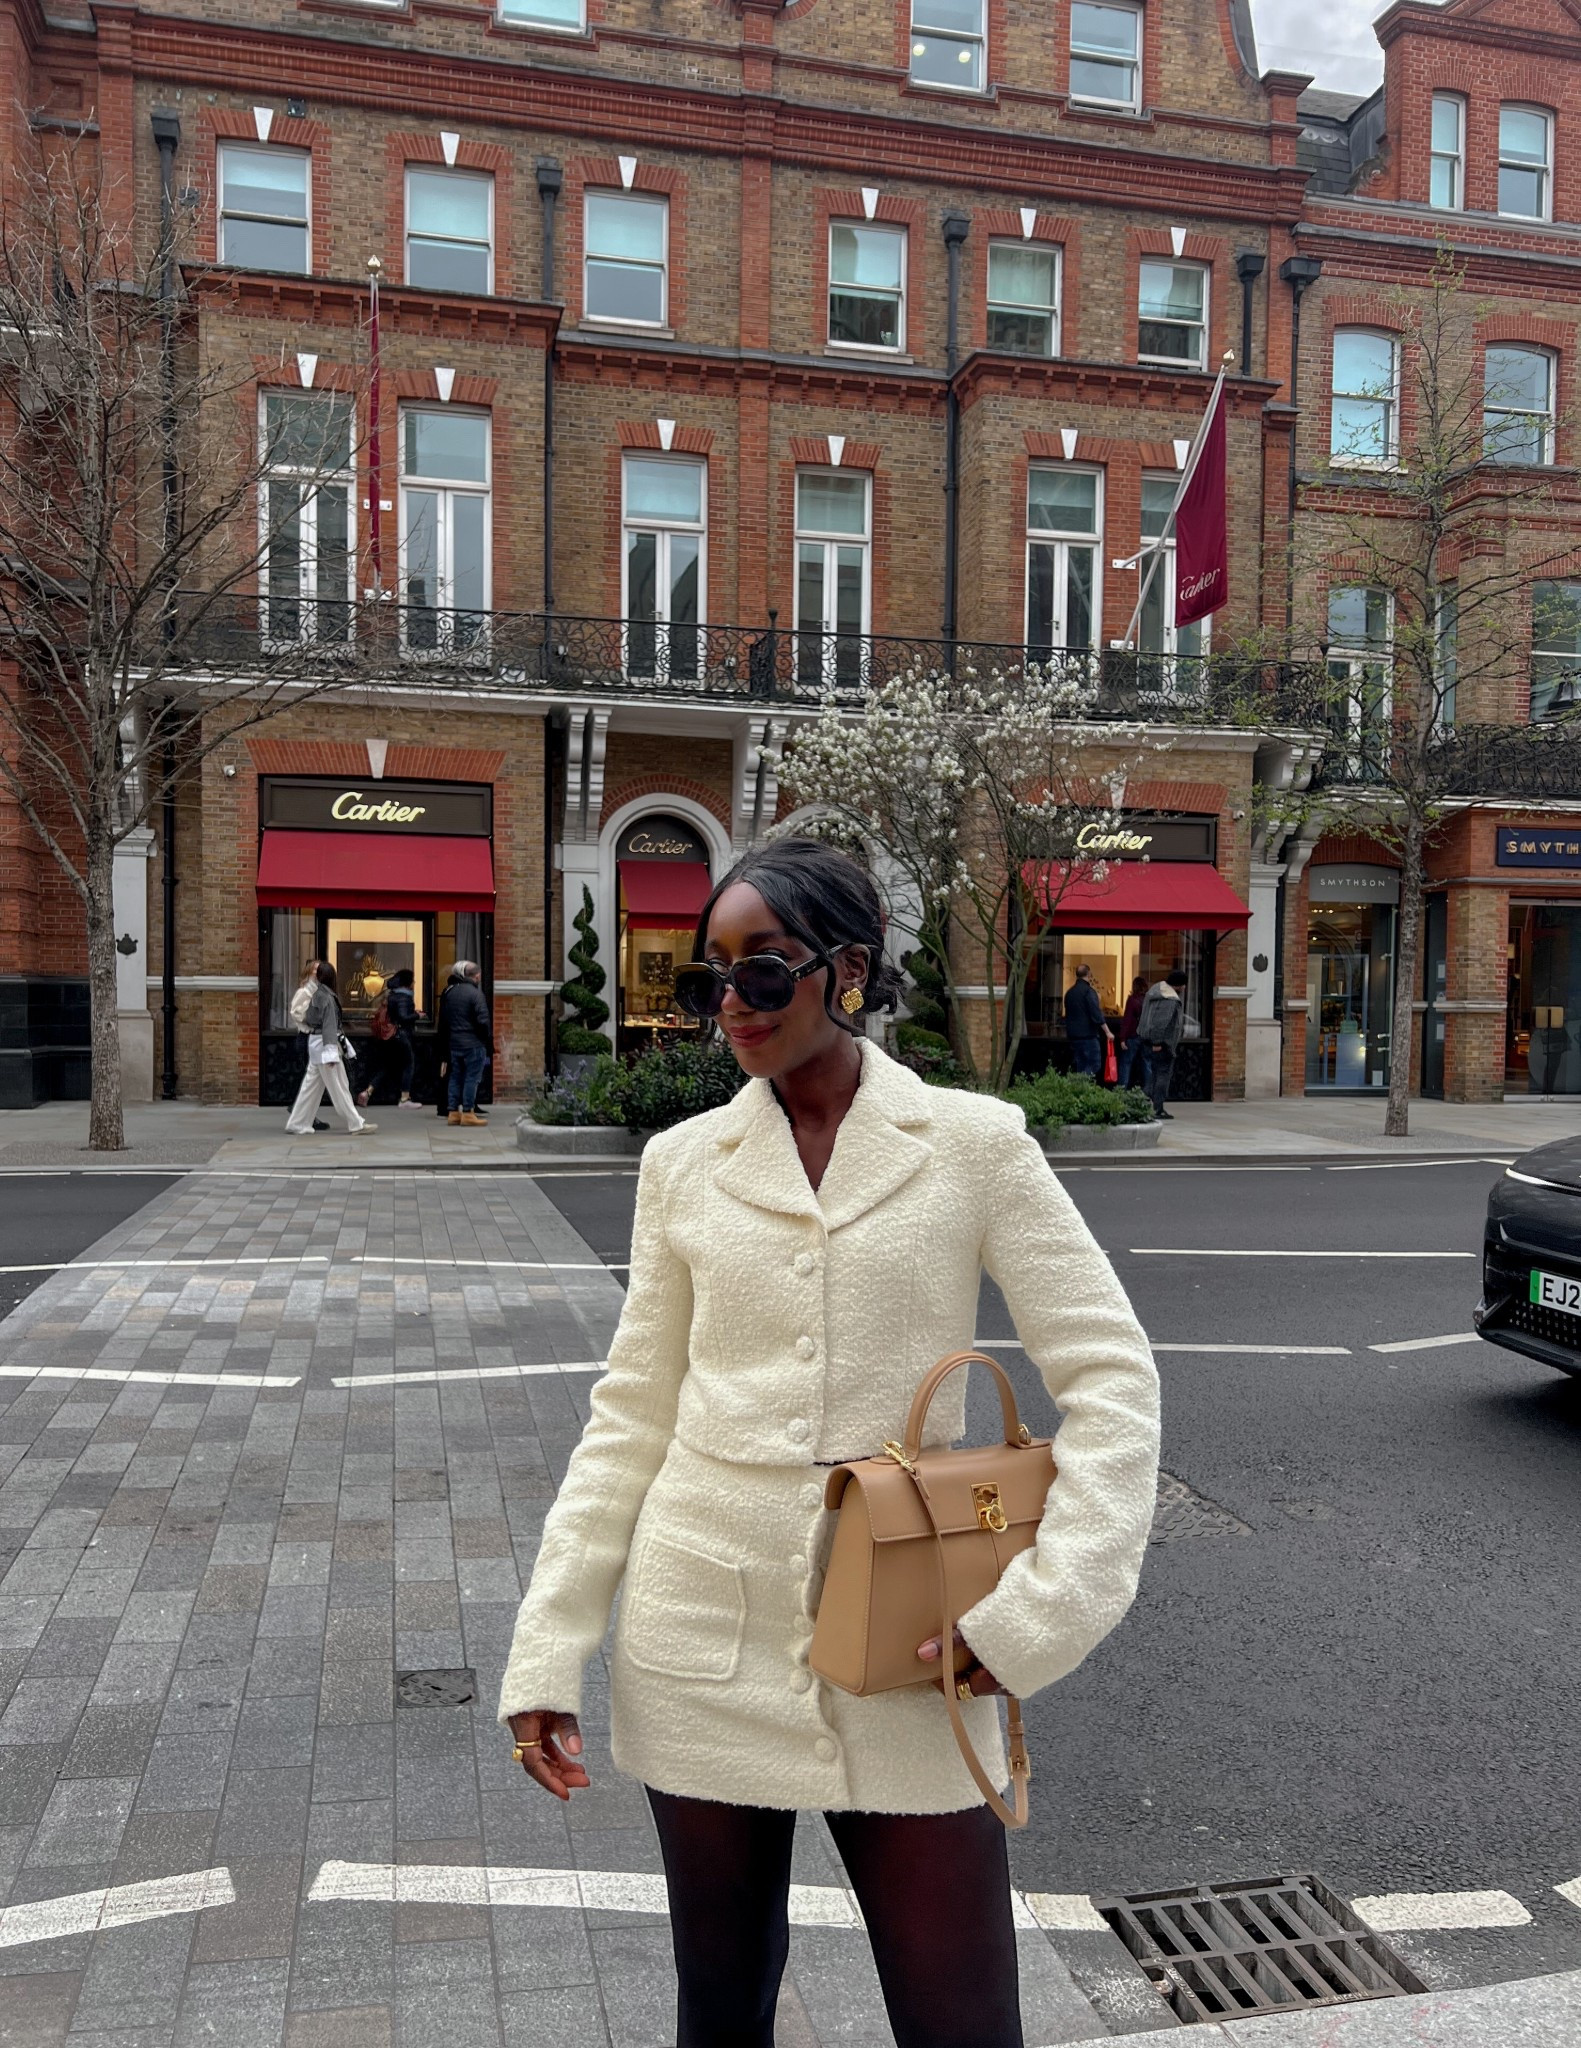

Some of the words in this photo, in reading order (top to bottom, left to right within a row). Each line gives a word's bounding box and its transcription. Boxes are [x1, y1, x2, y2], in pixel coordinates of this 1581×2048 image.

[331, 791, 426, 822] Cartier
[628, 833, 693, 854] Cartier
[1076, 823, 1153, 850] Cartier
[1320, 878, 1386, 887] SMYTHSON
